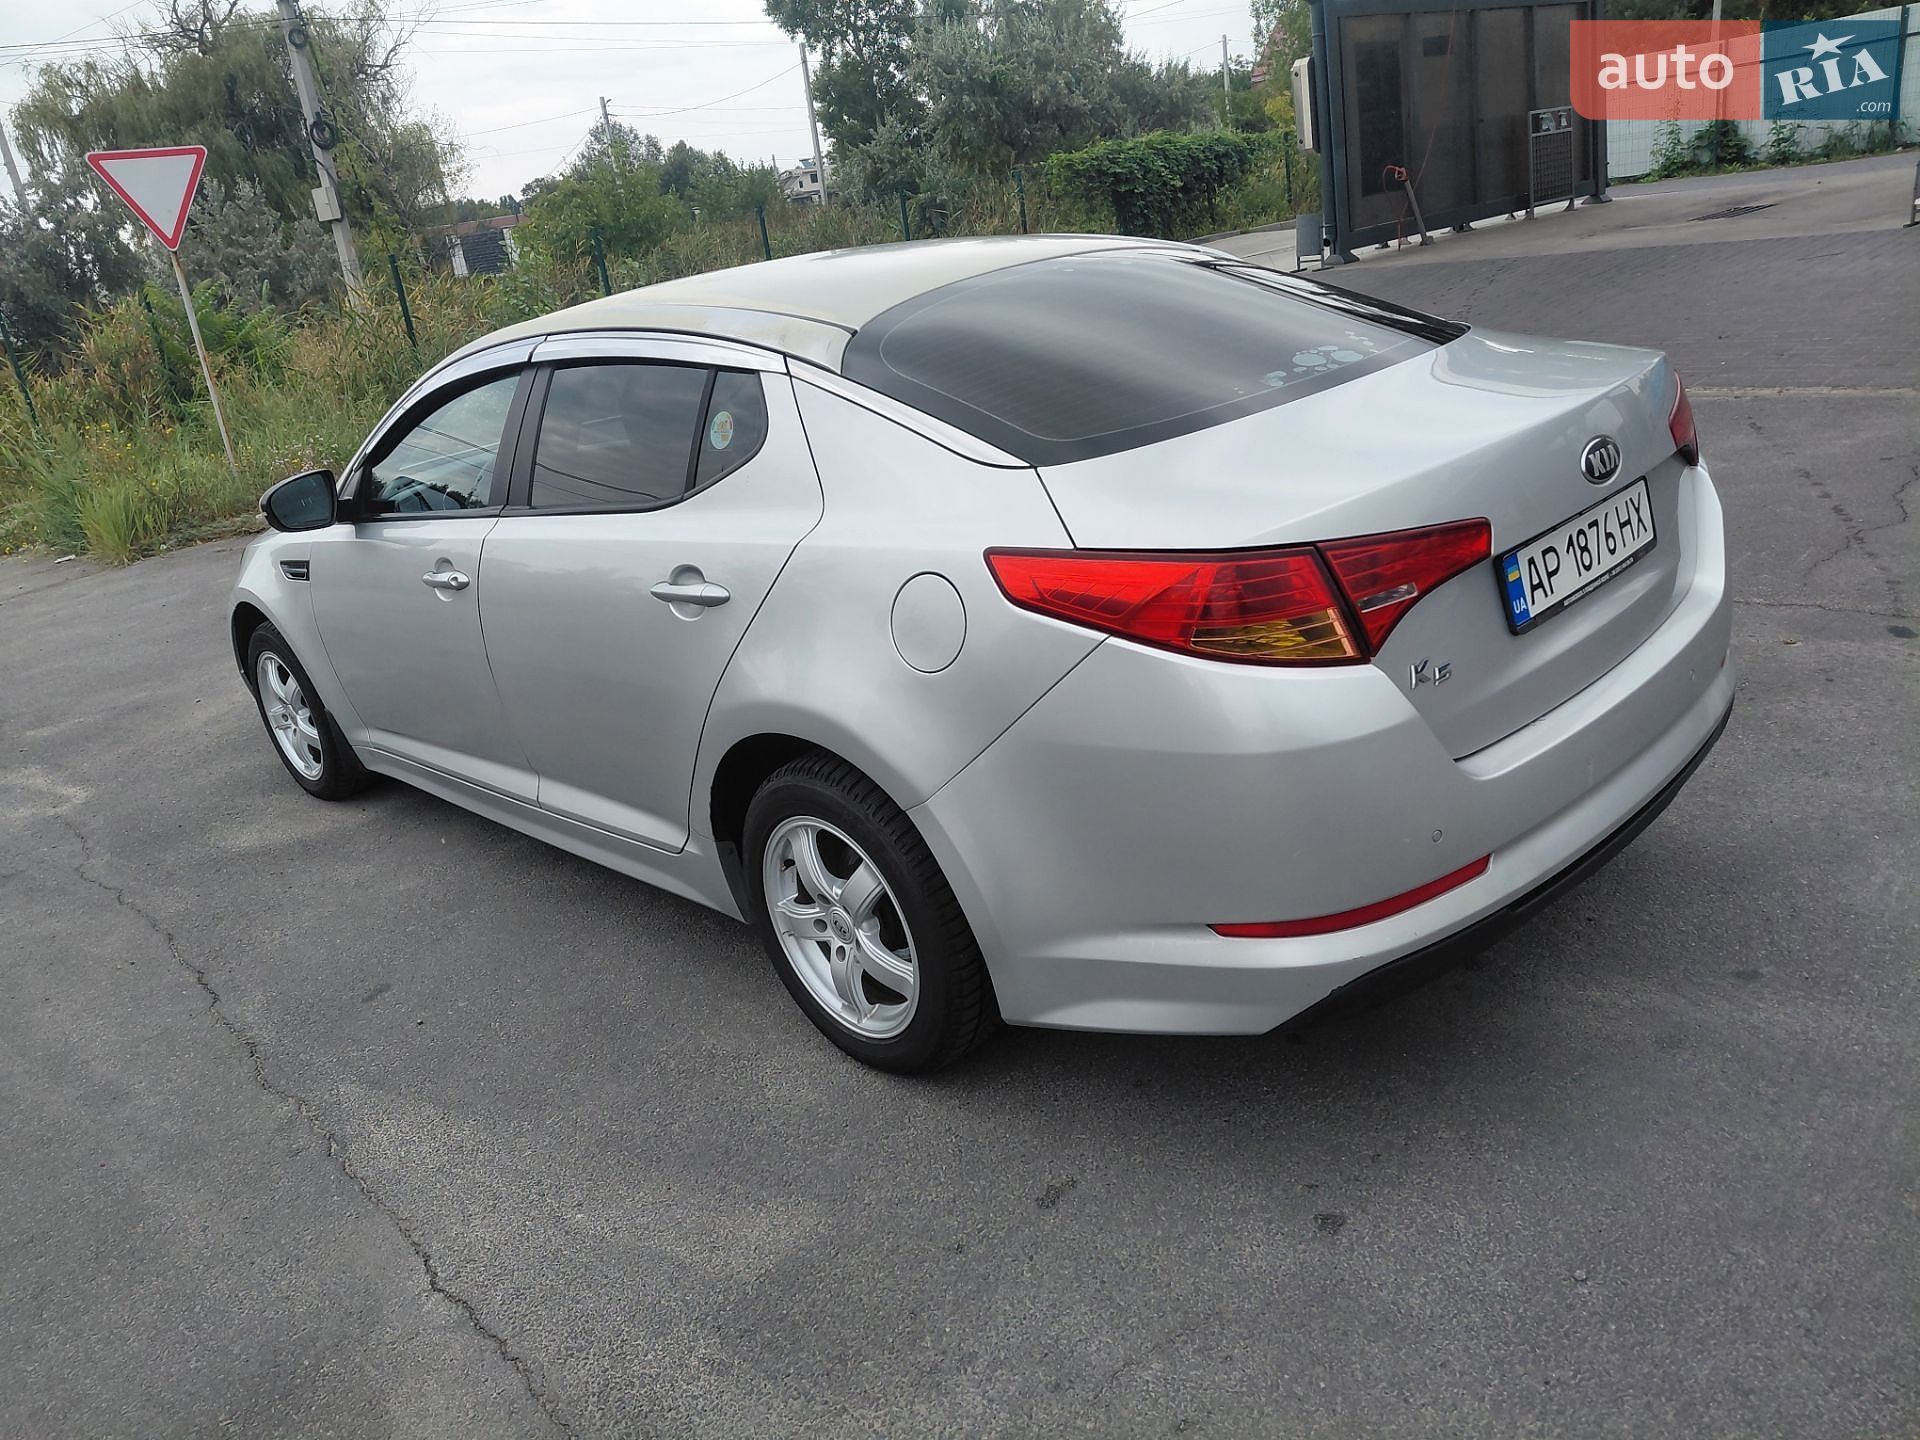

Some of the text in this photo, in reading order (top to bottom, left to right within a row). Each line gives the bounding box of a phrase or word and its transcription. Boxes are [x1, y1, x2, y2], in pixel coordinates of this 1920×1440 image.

[1588, 444, 1619, 477] KIA
[1527, 545, 1561, 606] AP
[1565, 511, 1617, 578] 1876
[1614, 491, 1648, 548] HX
[1512, 596, 1528, 614] UA
